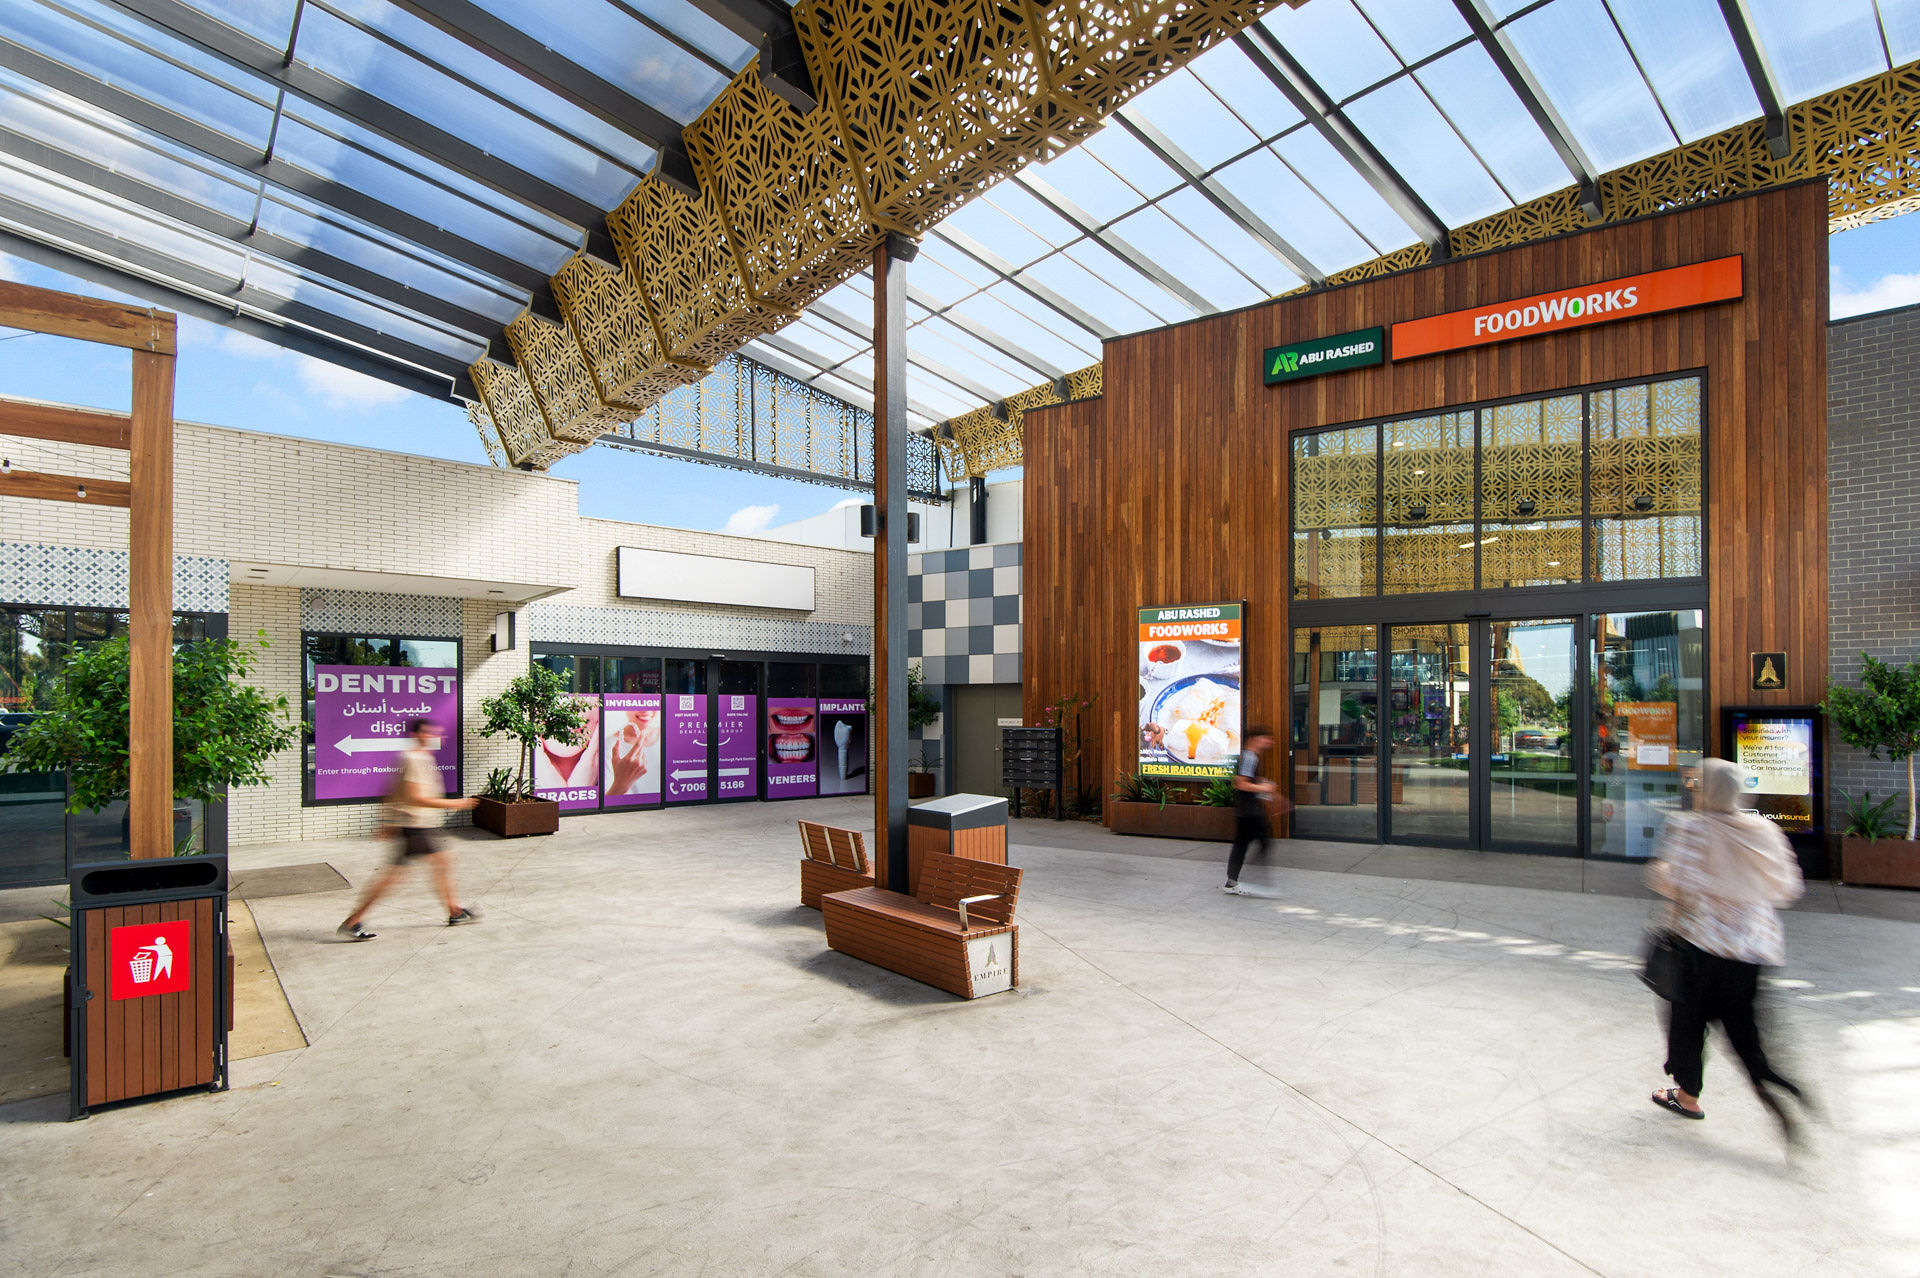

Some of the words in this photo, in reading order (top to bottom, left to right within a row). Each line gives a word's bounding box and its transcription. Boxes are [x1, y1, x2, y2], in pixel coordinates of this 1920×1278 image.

[1474, 286, 1638, 337] FOODWORKS
[1299, 351, 1324, 365] ABU
[1326, 341, 1375, 360] RASHED
[1157, 609, 1178, 621] ABU
[1179, 608, 1220, 619] RASHED
[1149, 622, 1228, 638] FOODWORKS
[317, 673, 457, 694] DENTIST
[343, 699, 387, 717] أسنان
[390, 702, 432, 717] طبيب
[605, 699, 660, 707] INVISALIGN
[820, 703, 867, 712] IMPLANTS
[370, 721, 407, 736] dişçi
[340, 766, 371, 775] through
[1142, 764, 1169, 775] FRESH
[680, 782, 706, 792] 7006
[720, 780, 745, 790] 5166
[768, 774, 817, 785] VENEERS
[974, 967, 1008, 982] EMPIRE
